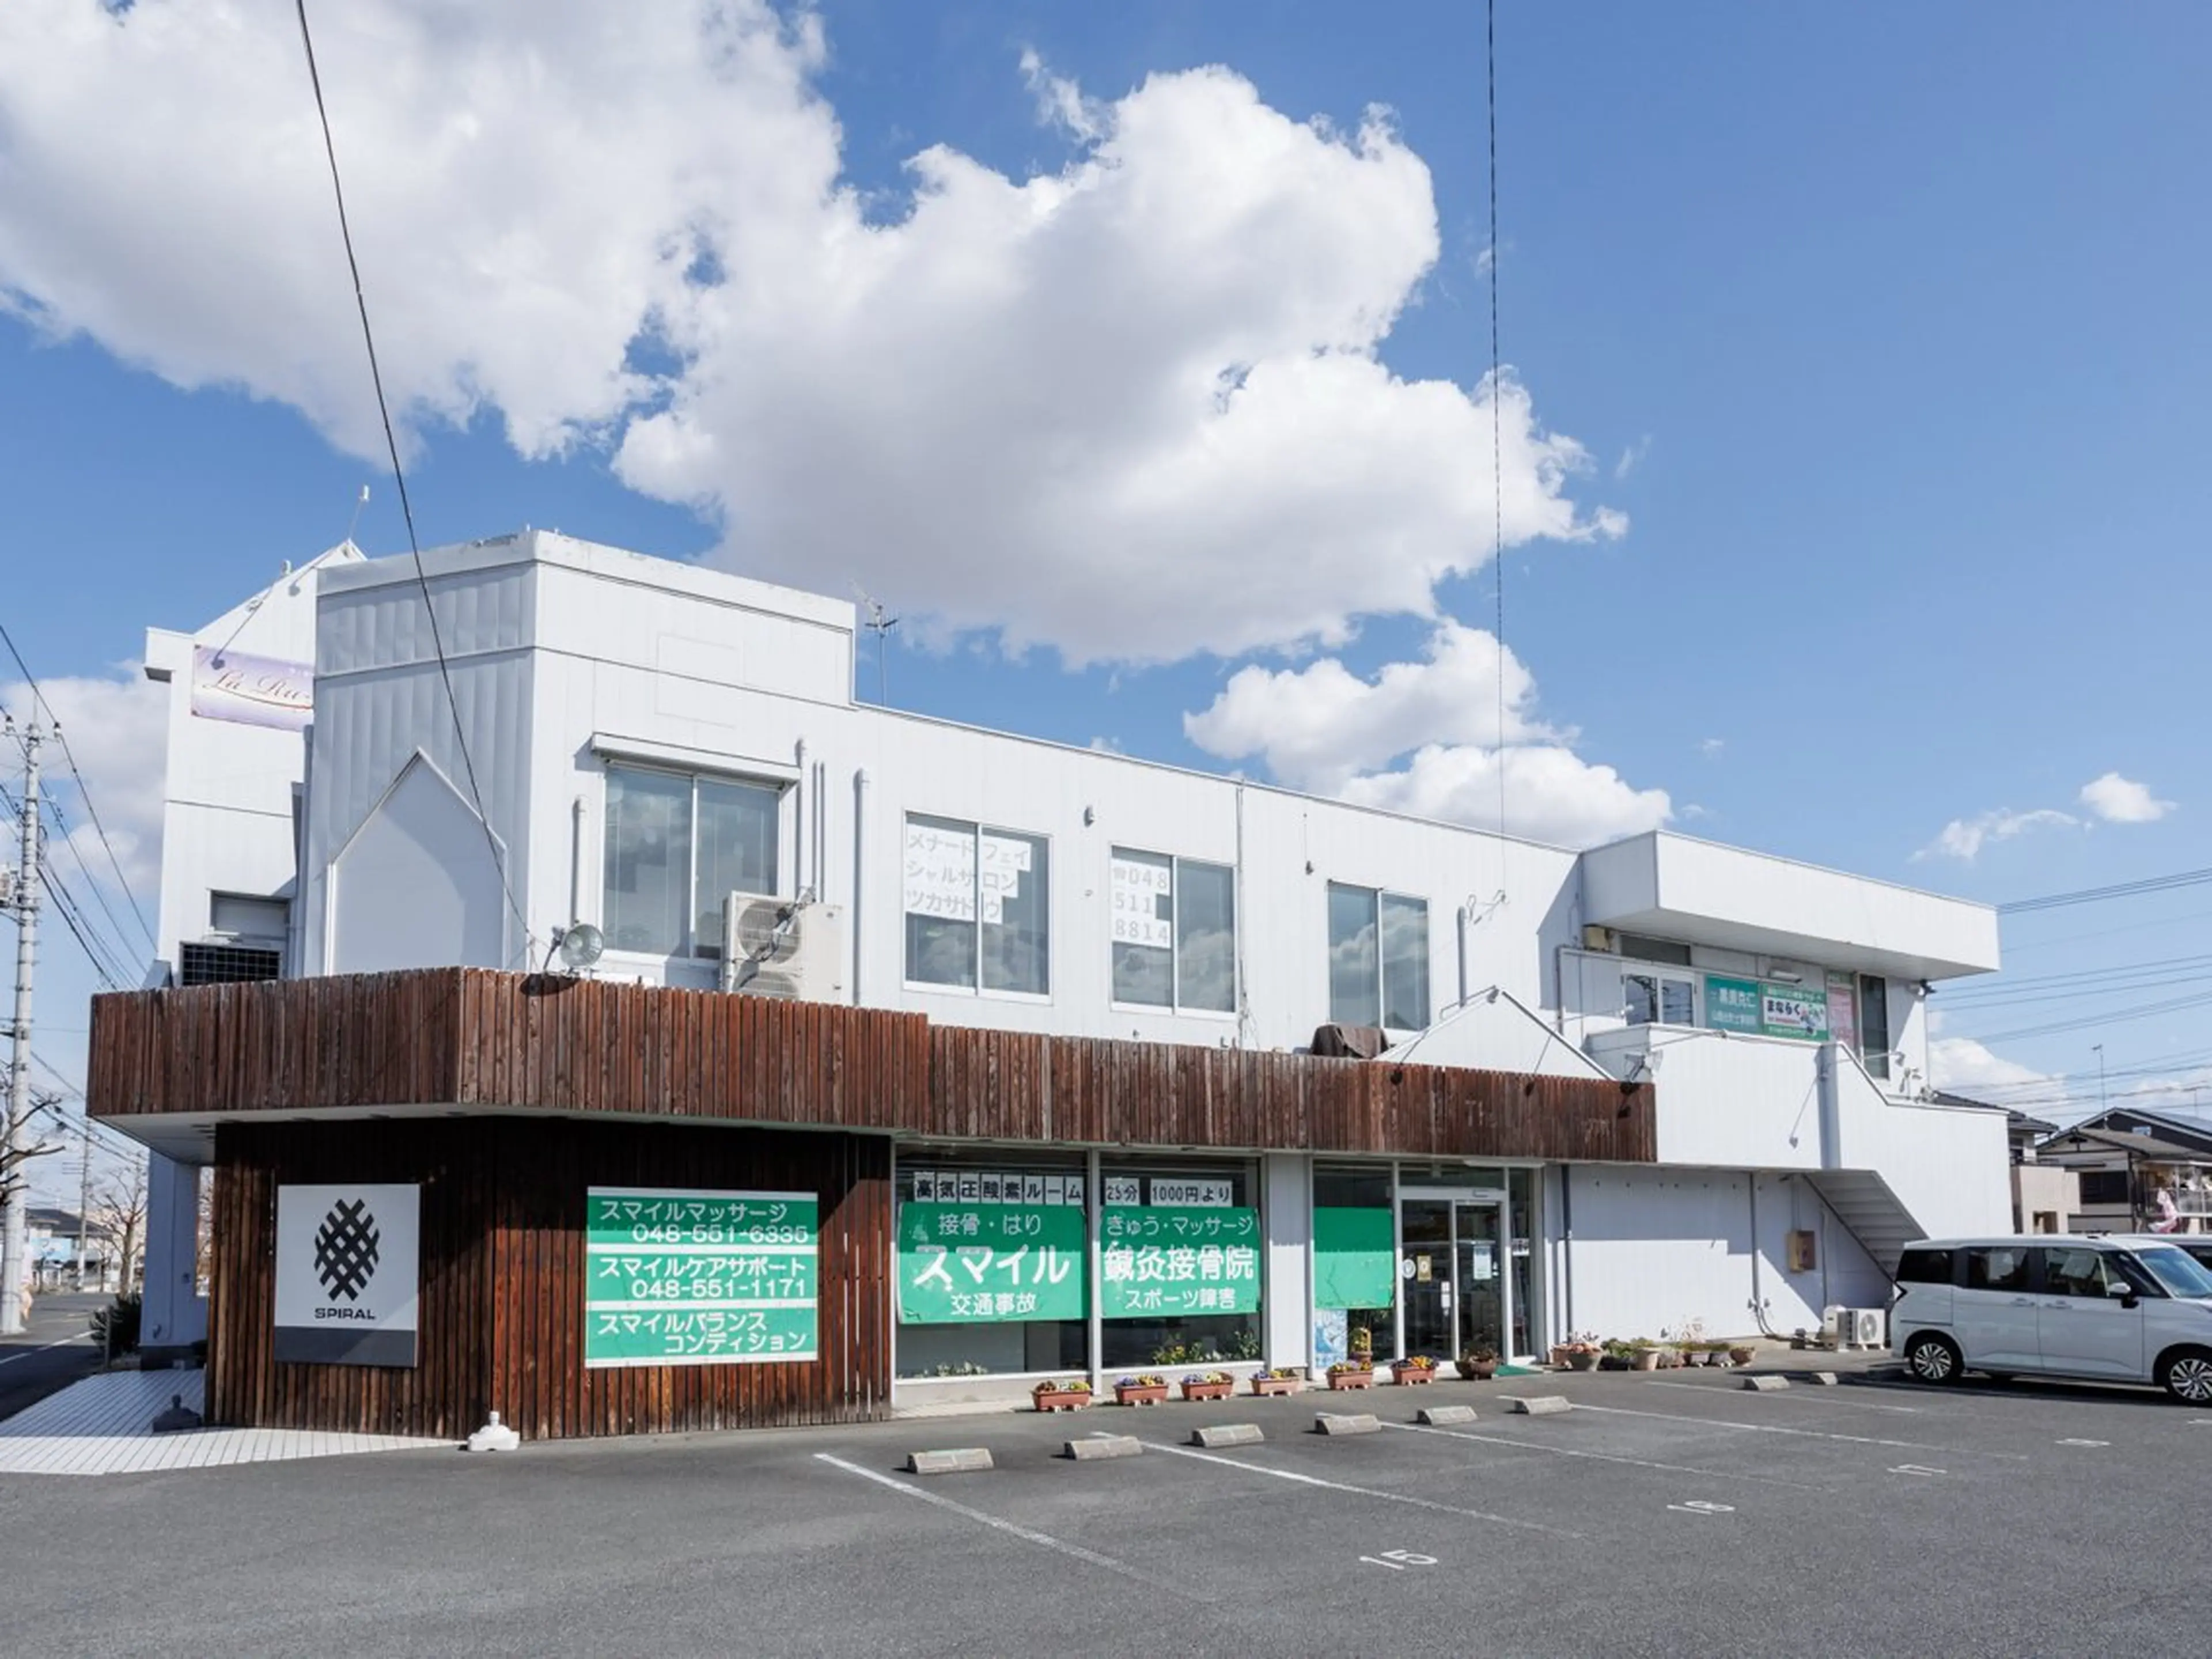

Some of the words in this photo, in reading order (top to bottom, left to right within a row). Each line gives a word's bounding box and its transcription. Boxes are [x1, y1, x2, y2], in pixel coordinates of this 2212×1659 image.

[1115, 892, 1152, 914] 511
[1115, 918, 1168, 944] 8814
[916, 1179, 1081, 1200] 高気圧酸素ルーム
[1107, 1184, 1138, 1201] 25分
[1152, 1185, 1230, 1202] 1000円より
[600, 1200, 787, 1222] スマイルマッサージ
[632, 1224, 808, 1243] 048-551-6335
[599, 1256, 806, 1278] スマイルケアサポート
[914, 1244, 1070, 1285] スマイル
[1104, 1242, 1254, 1282] 鍼灸接骨院
[632, 1279, 805, 1298] 048-551-1171
[1125, 1288, 1236, 1309] スポーツ障害
[315, 1308, 376, 1320] SPIRAL
[950, 1293, 1036, 1315] 交通事故
[598, 1311, 767, 1335] スマイルバランス
[664, 1332, 806, 1354] コンディション
[1359, 1550, 1438, 1570] 15
